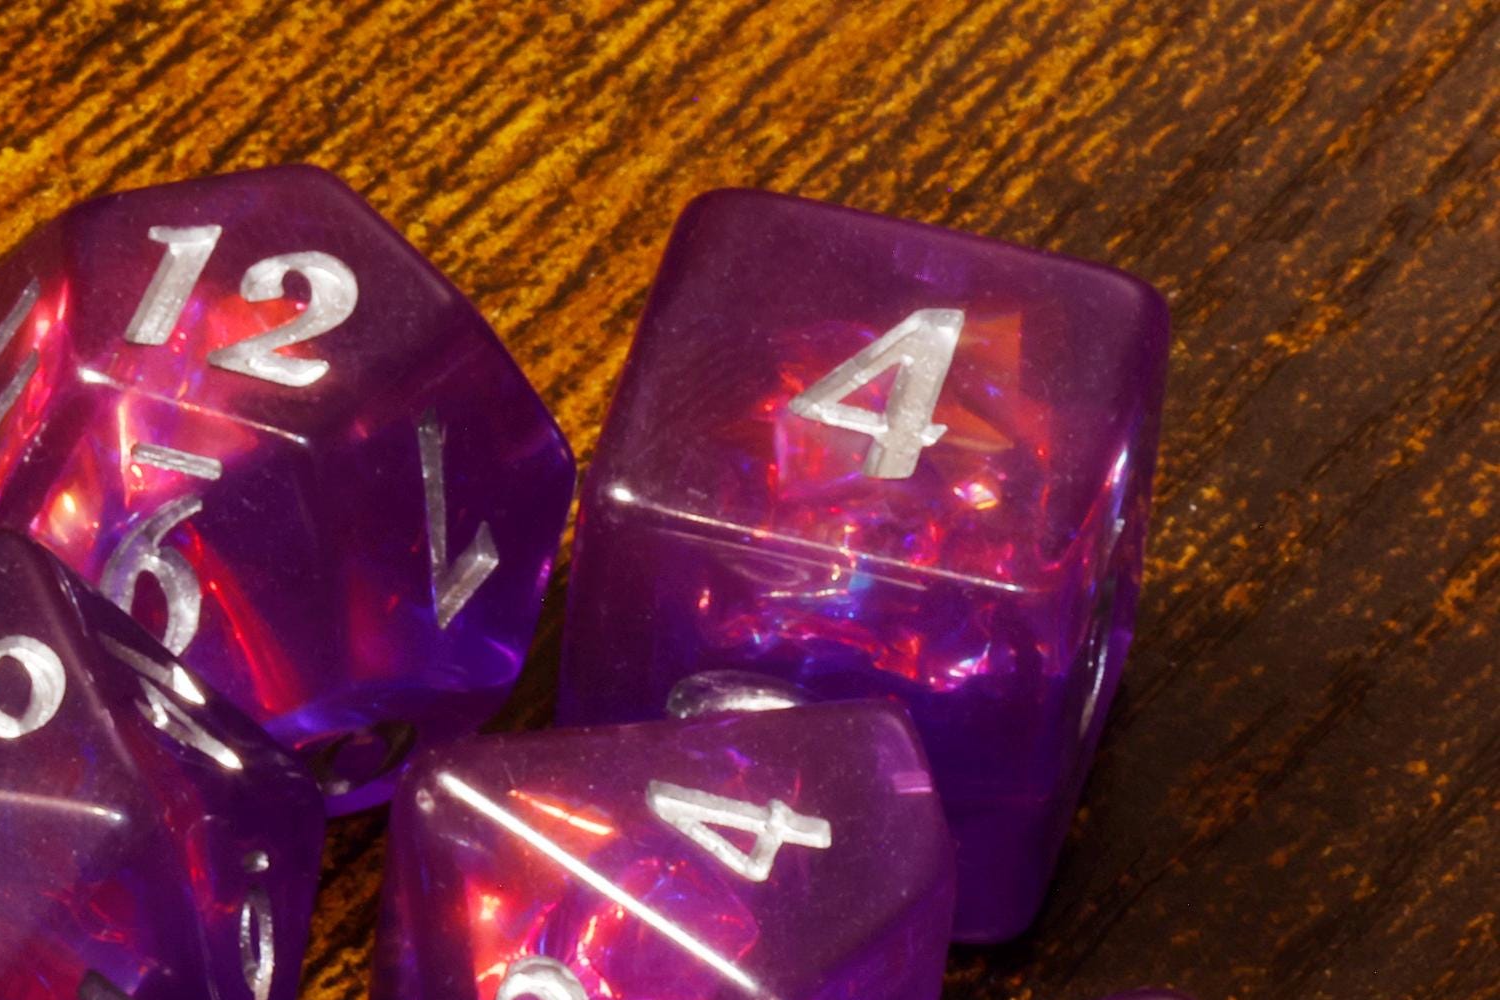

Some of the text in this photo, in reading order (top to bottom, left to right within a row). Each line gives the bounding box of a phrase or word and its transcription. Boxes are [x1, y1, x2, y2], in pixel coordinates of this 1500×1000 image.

[123, 224, 359, 388] 12
[788, 308, 965, 480] 4
[645, 778, 832, 883] 4
